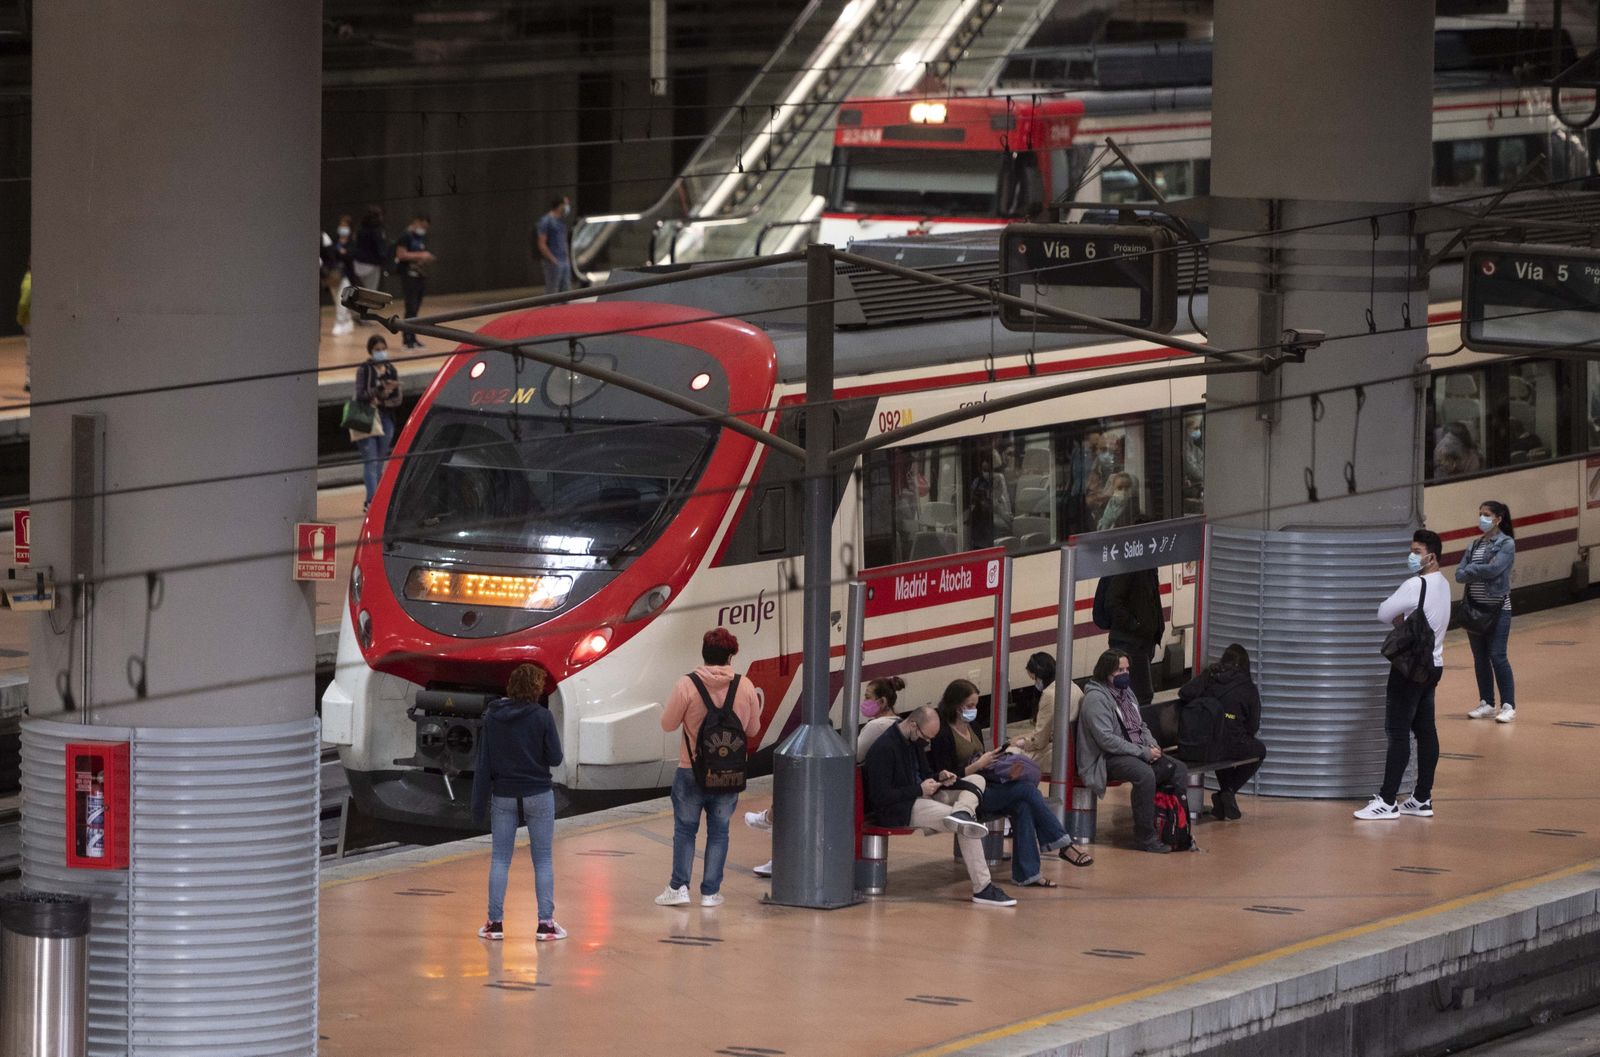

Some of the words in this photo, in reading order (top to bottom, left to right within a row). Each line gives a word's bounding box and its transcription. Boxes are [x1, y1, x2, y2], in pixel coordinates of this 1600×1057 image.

[1043, 241, 1070, 259] Vía
[1085, 242, 1097, 259] 6
[1113, 243, 1147, 253] Próximo
[1515, 262, 1544, 280] Vía
[1557, 264, 1569, 281] 5
[1124, 539, 1144, 559] Salida
[895, 572, 928, 600] Madrid
[938, 566, 972, 593] Atocha
[718, 588, 775, 635] renfe
